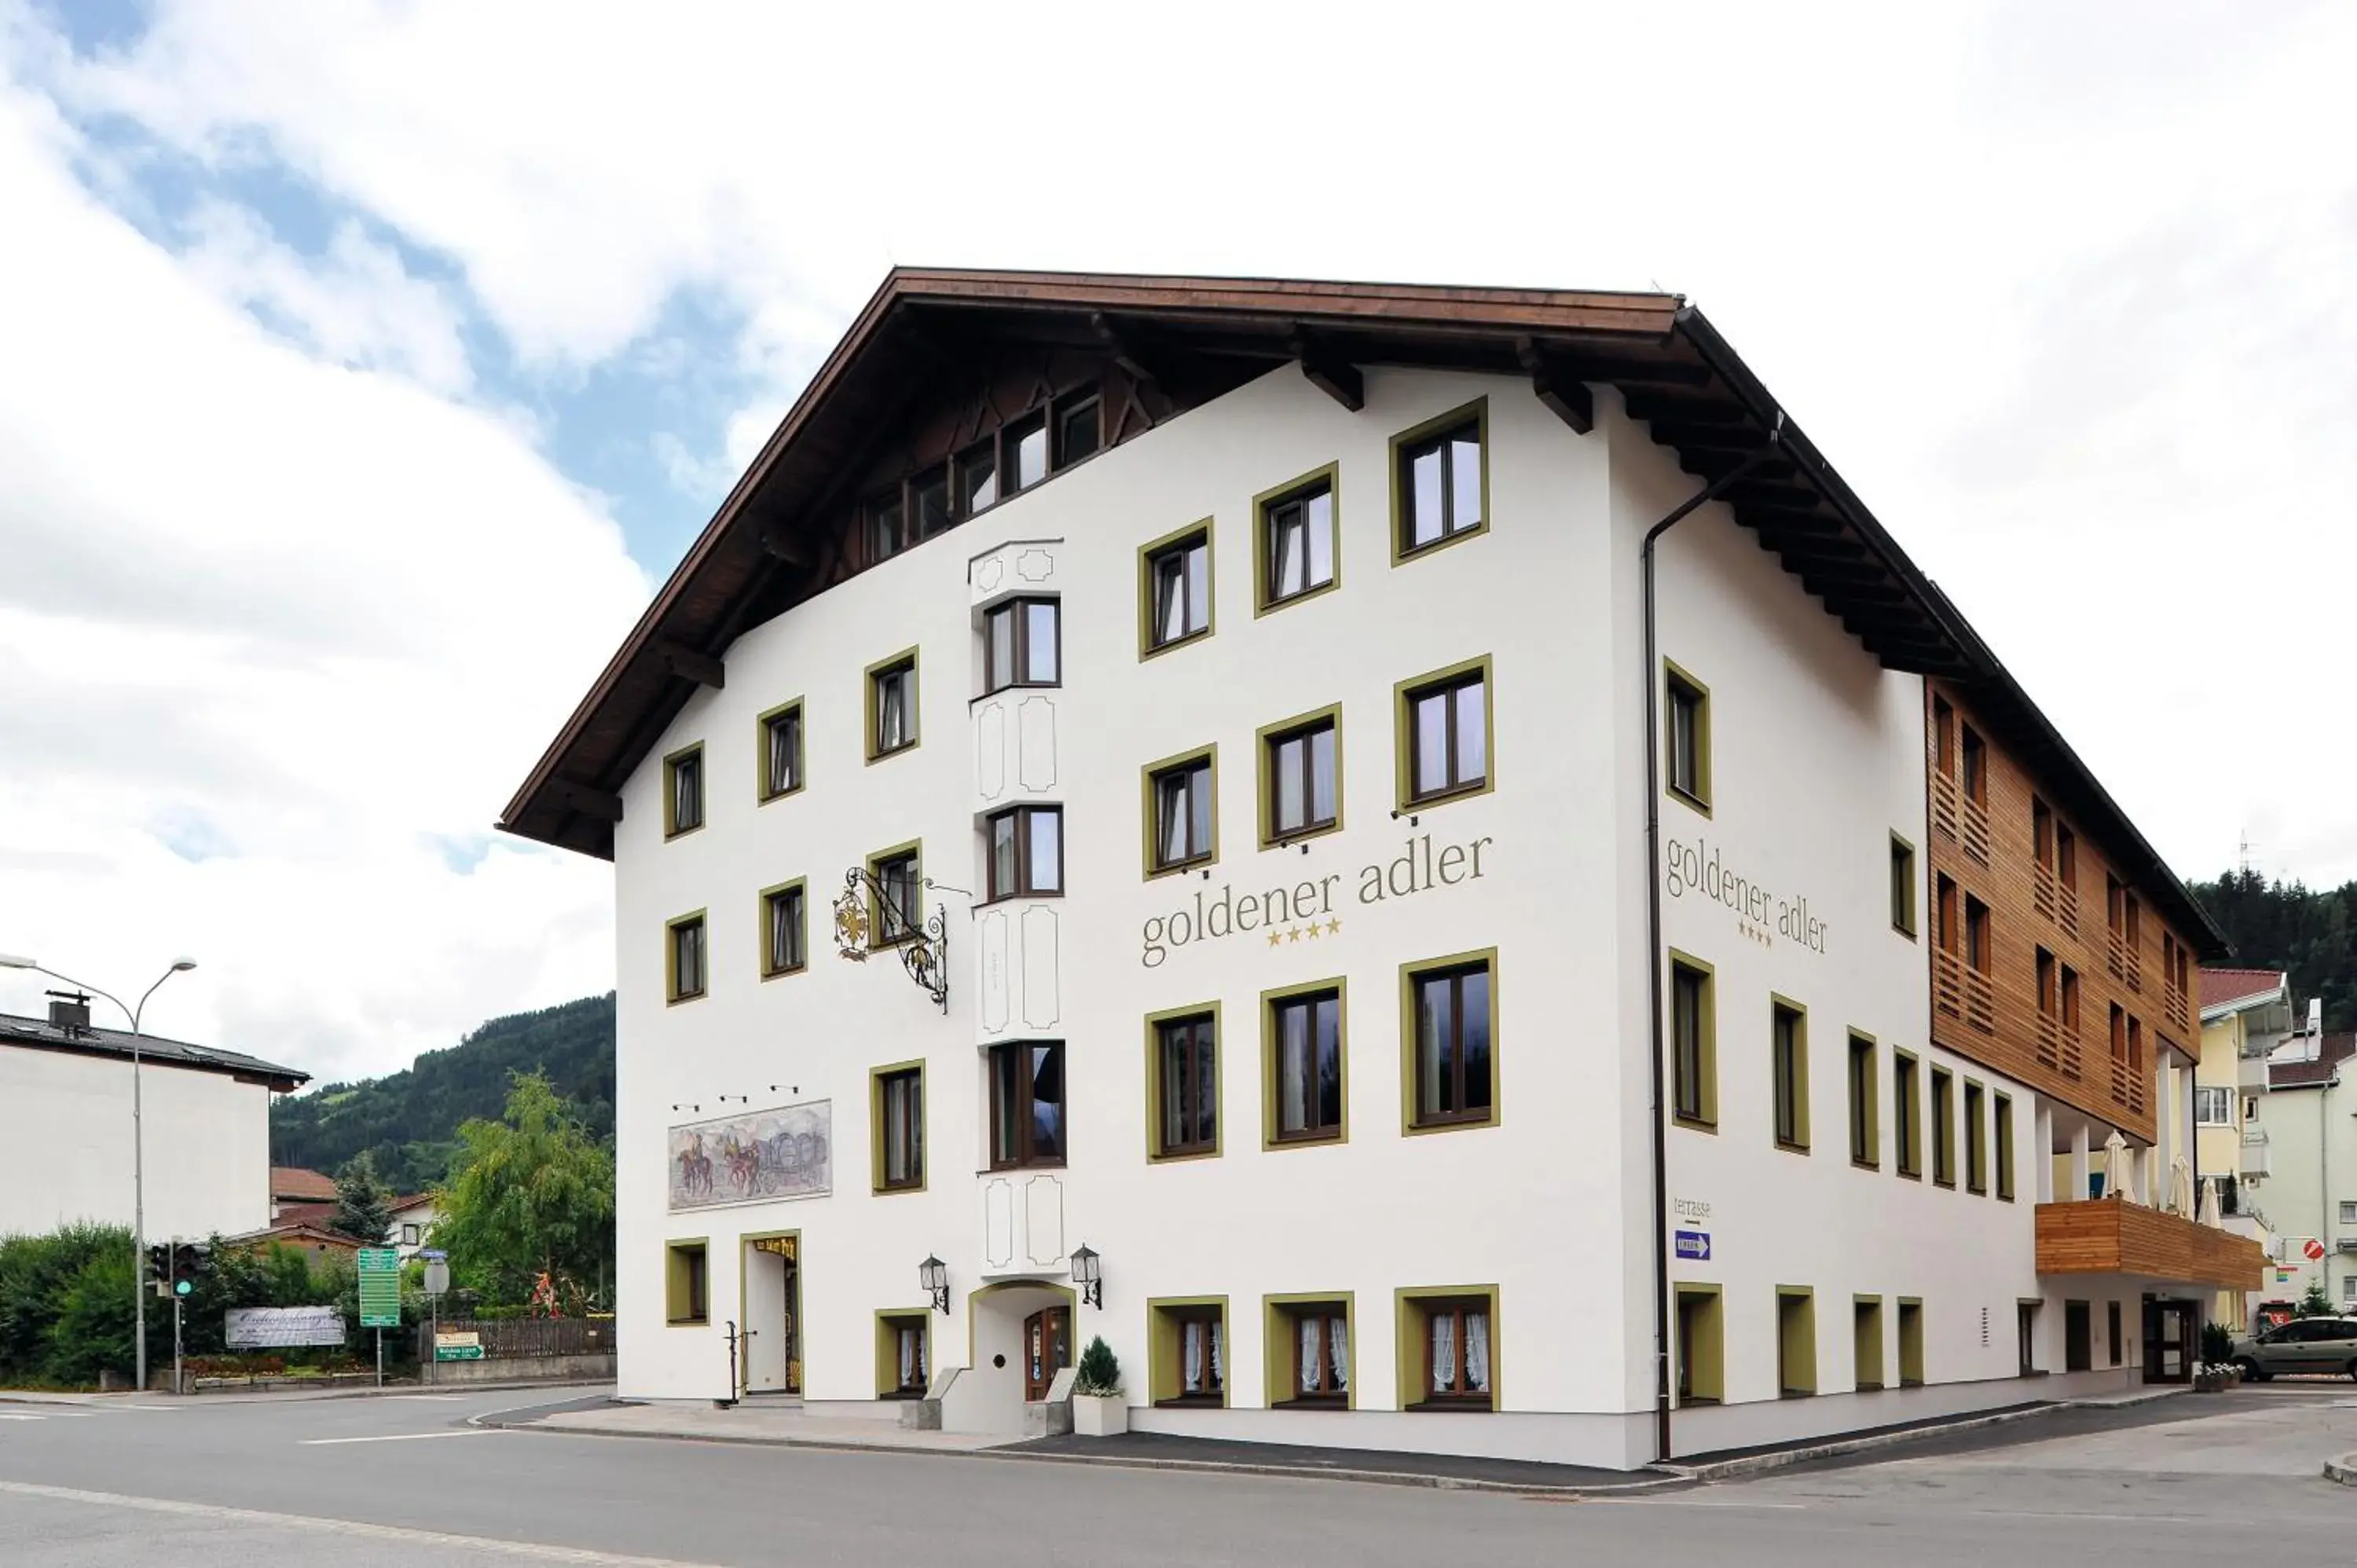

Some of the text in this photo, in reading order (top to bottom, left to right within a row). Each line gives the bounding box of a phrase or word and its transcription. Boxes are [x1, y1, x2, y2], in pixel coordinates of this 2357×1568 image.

[1142, 833, 1493, 968] goldener adler
[1666, 838, 1827, 954] goldener adler
